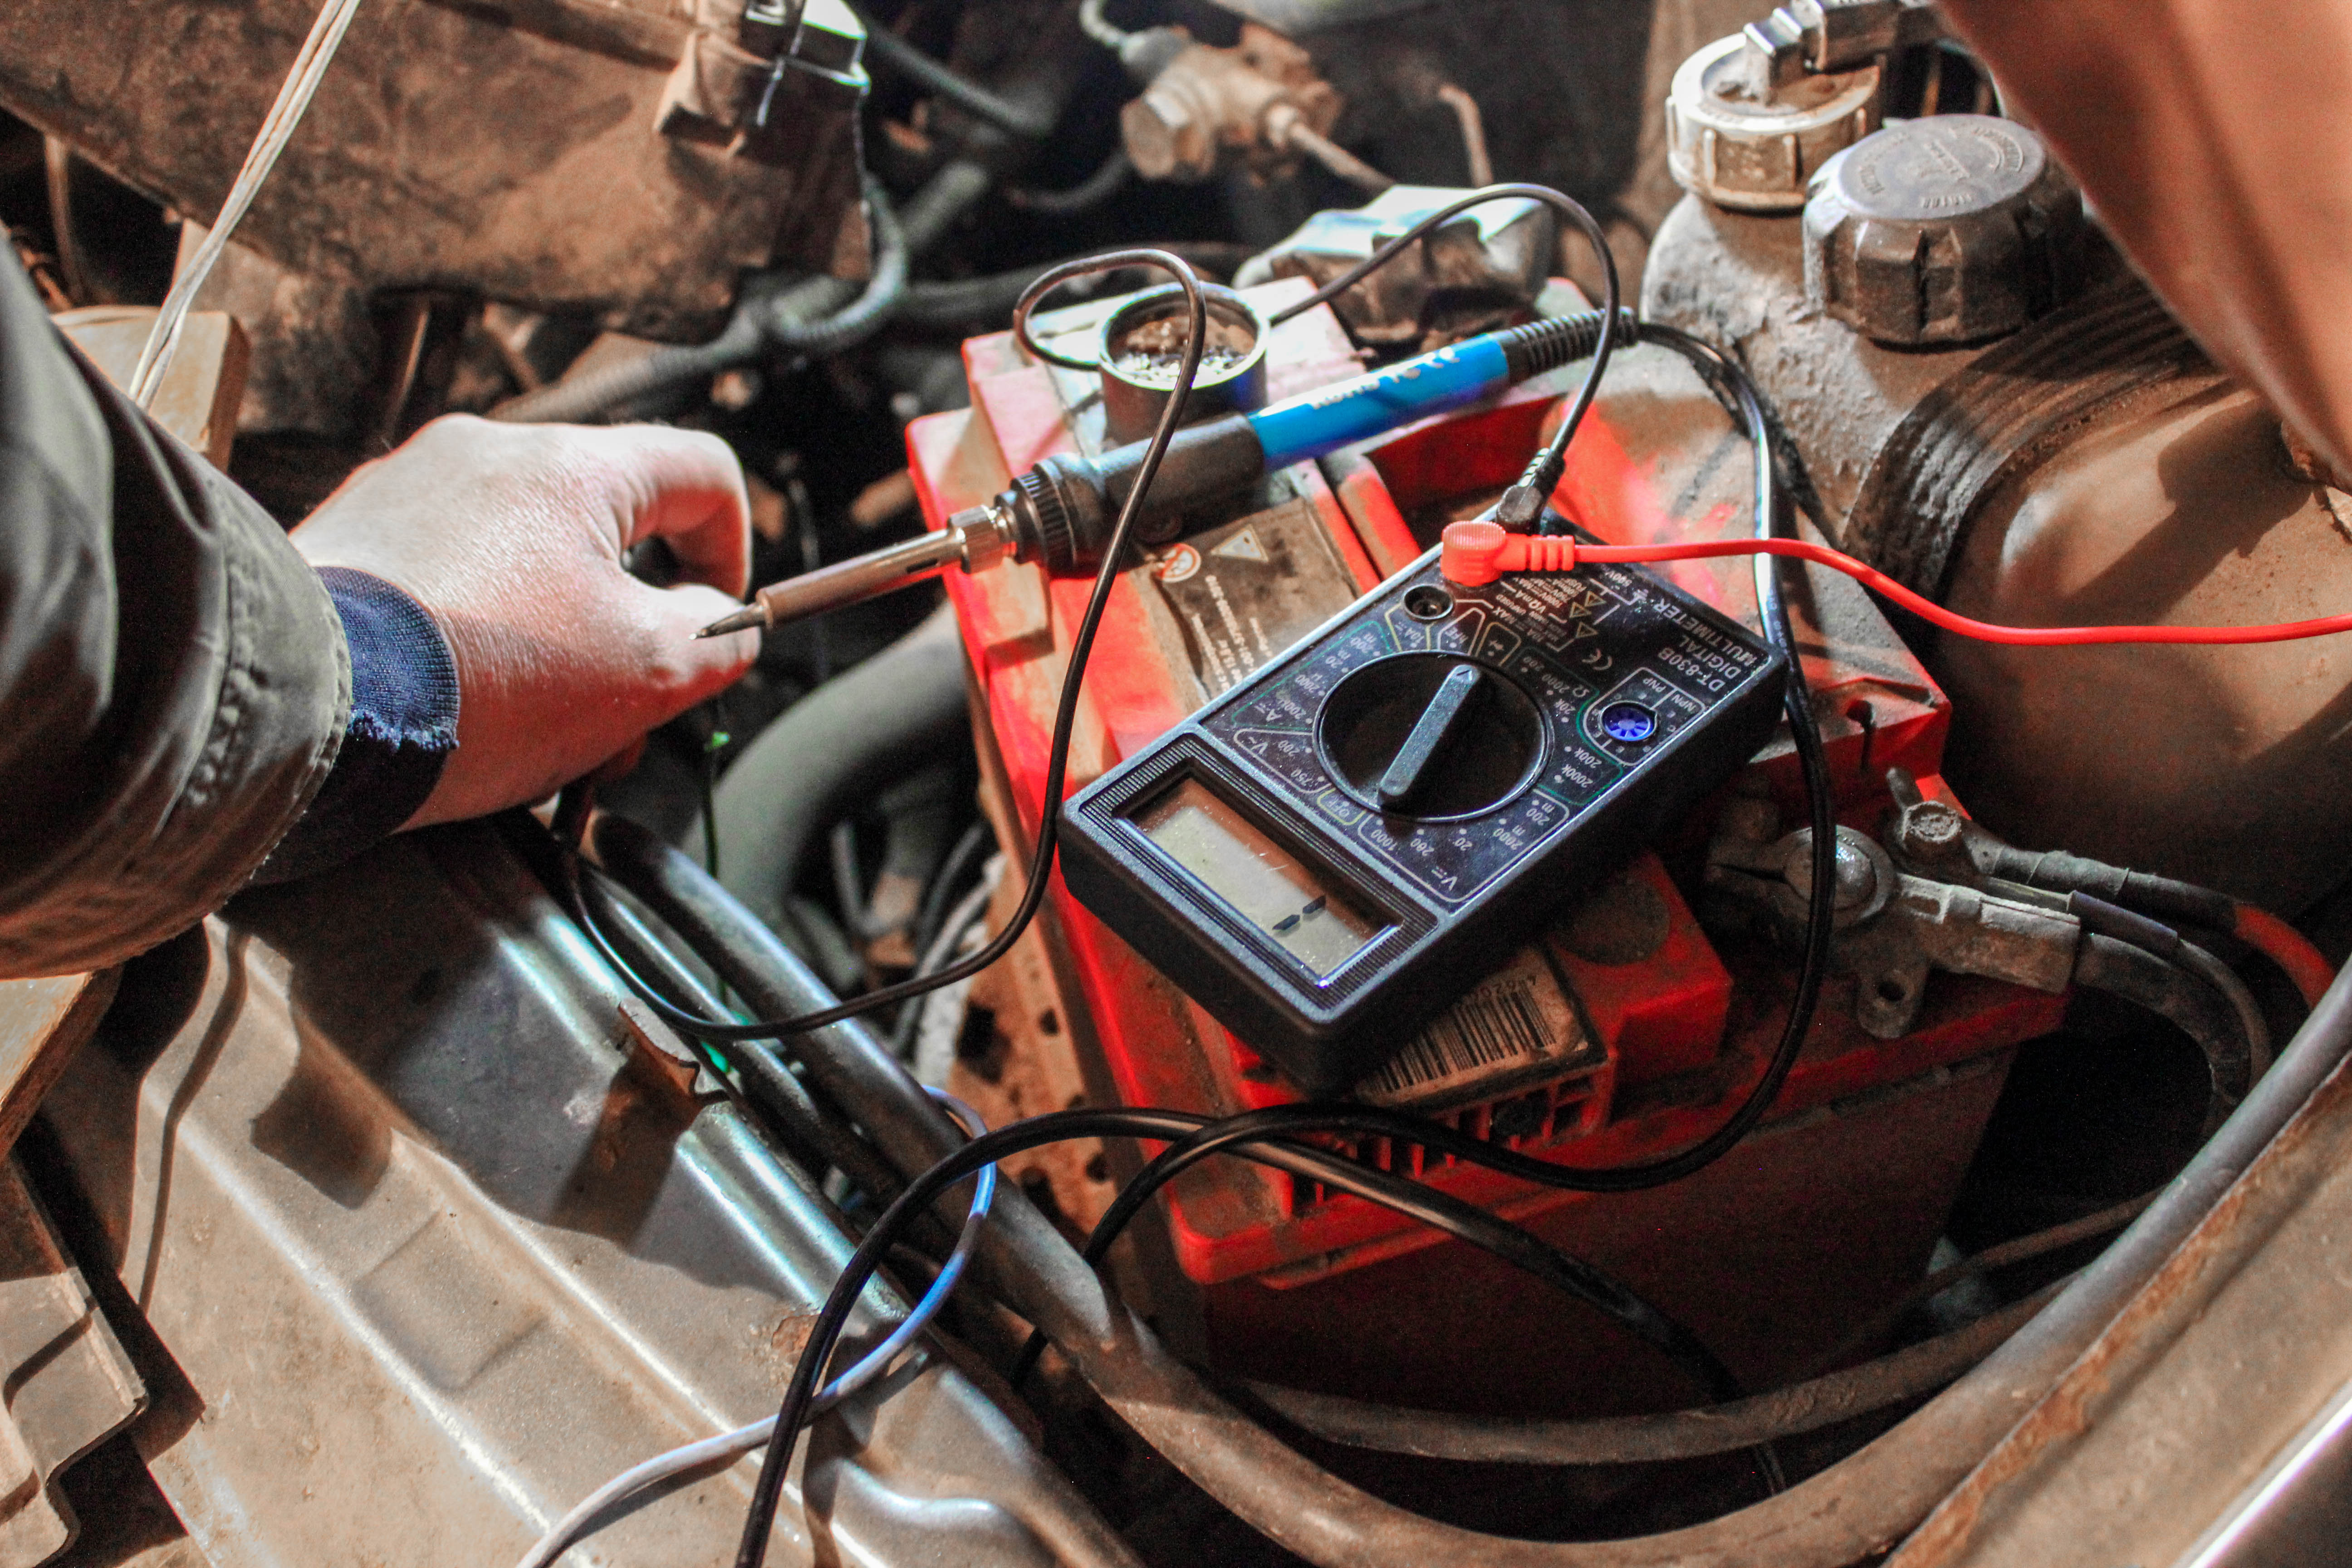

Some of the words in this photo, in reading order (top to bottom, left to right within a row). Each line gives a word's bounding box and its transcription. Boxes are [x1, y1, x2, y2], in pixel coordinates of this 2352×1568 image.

[1492, 606, 1517, 625] MAX
[1652, 598, 1757, 666] MULTIMETER
[1325, 656, 1343, 669] 20
[1679, 635, 1741, 680] DIGITAL
[1658, 647, 1725, 692] DT-830B
[1294, 674, 1320, 693] 2000
[1542, 673, 1570, 694] 2000
[1642, 677, 1666, 693] PNP
[1671, 693, 1697, 712] NPN
[1278, 740, 1300, 757] 200
[1290, 769, 1313, 787] 750
[1526, 808, 1550, 826] 200
[1370, 829, 1398, 851] 1000
[1454, 838, 1473, 851] 20
[1493, 828, 1524, 850] 2000
